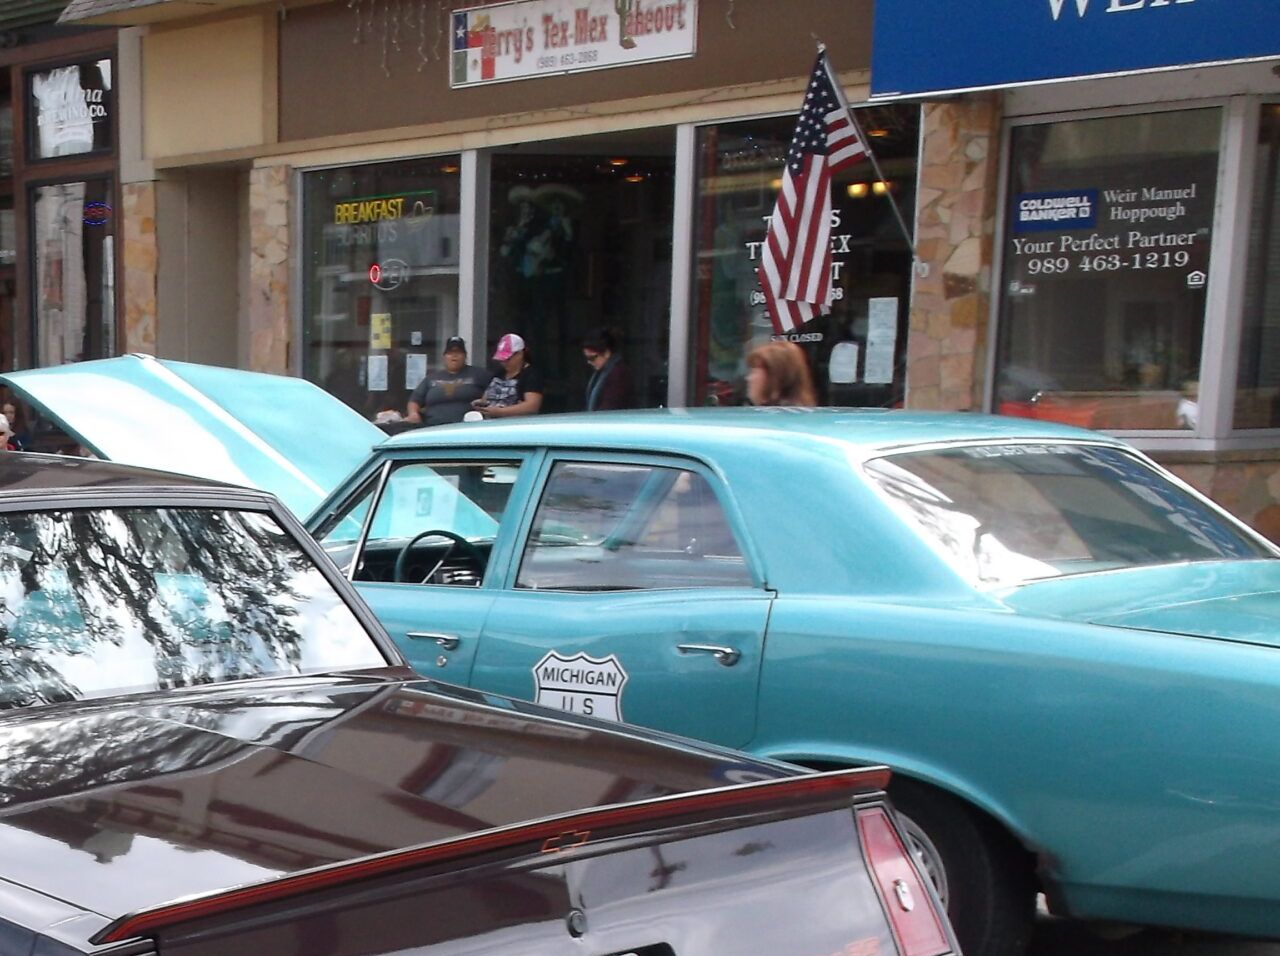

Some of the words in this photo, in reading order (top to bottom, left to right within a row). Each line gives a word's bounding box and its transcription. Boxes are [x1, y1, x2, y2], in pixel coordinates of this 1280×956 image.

[542, 7, 608, 49] Tex-Mex
[1104, 189, 1138, 203] Weir
[1142, 183, 1197, 201] Manuel
[334, 198, 404, 225] BREAKFAST
[1110, 202, 1186, 223] Hoppough
[1013, 238, 1055, 255] Your
[1060, 233, 1119, 252] Perfect
[1127, 231, 1197, 248] Partner
[1028, 257, 1070, 275] 989
[1079, 250, 1190, 272] 463-1219
[789, 333, 824, 343] CLOSED
[542, 666, 617, 687] MICHIGAN
